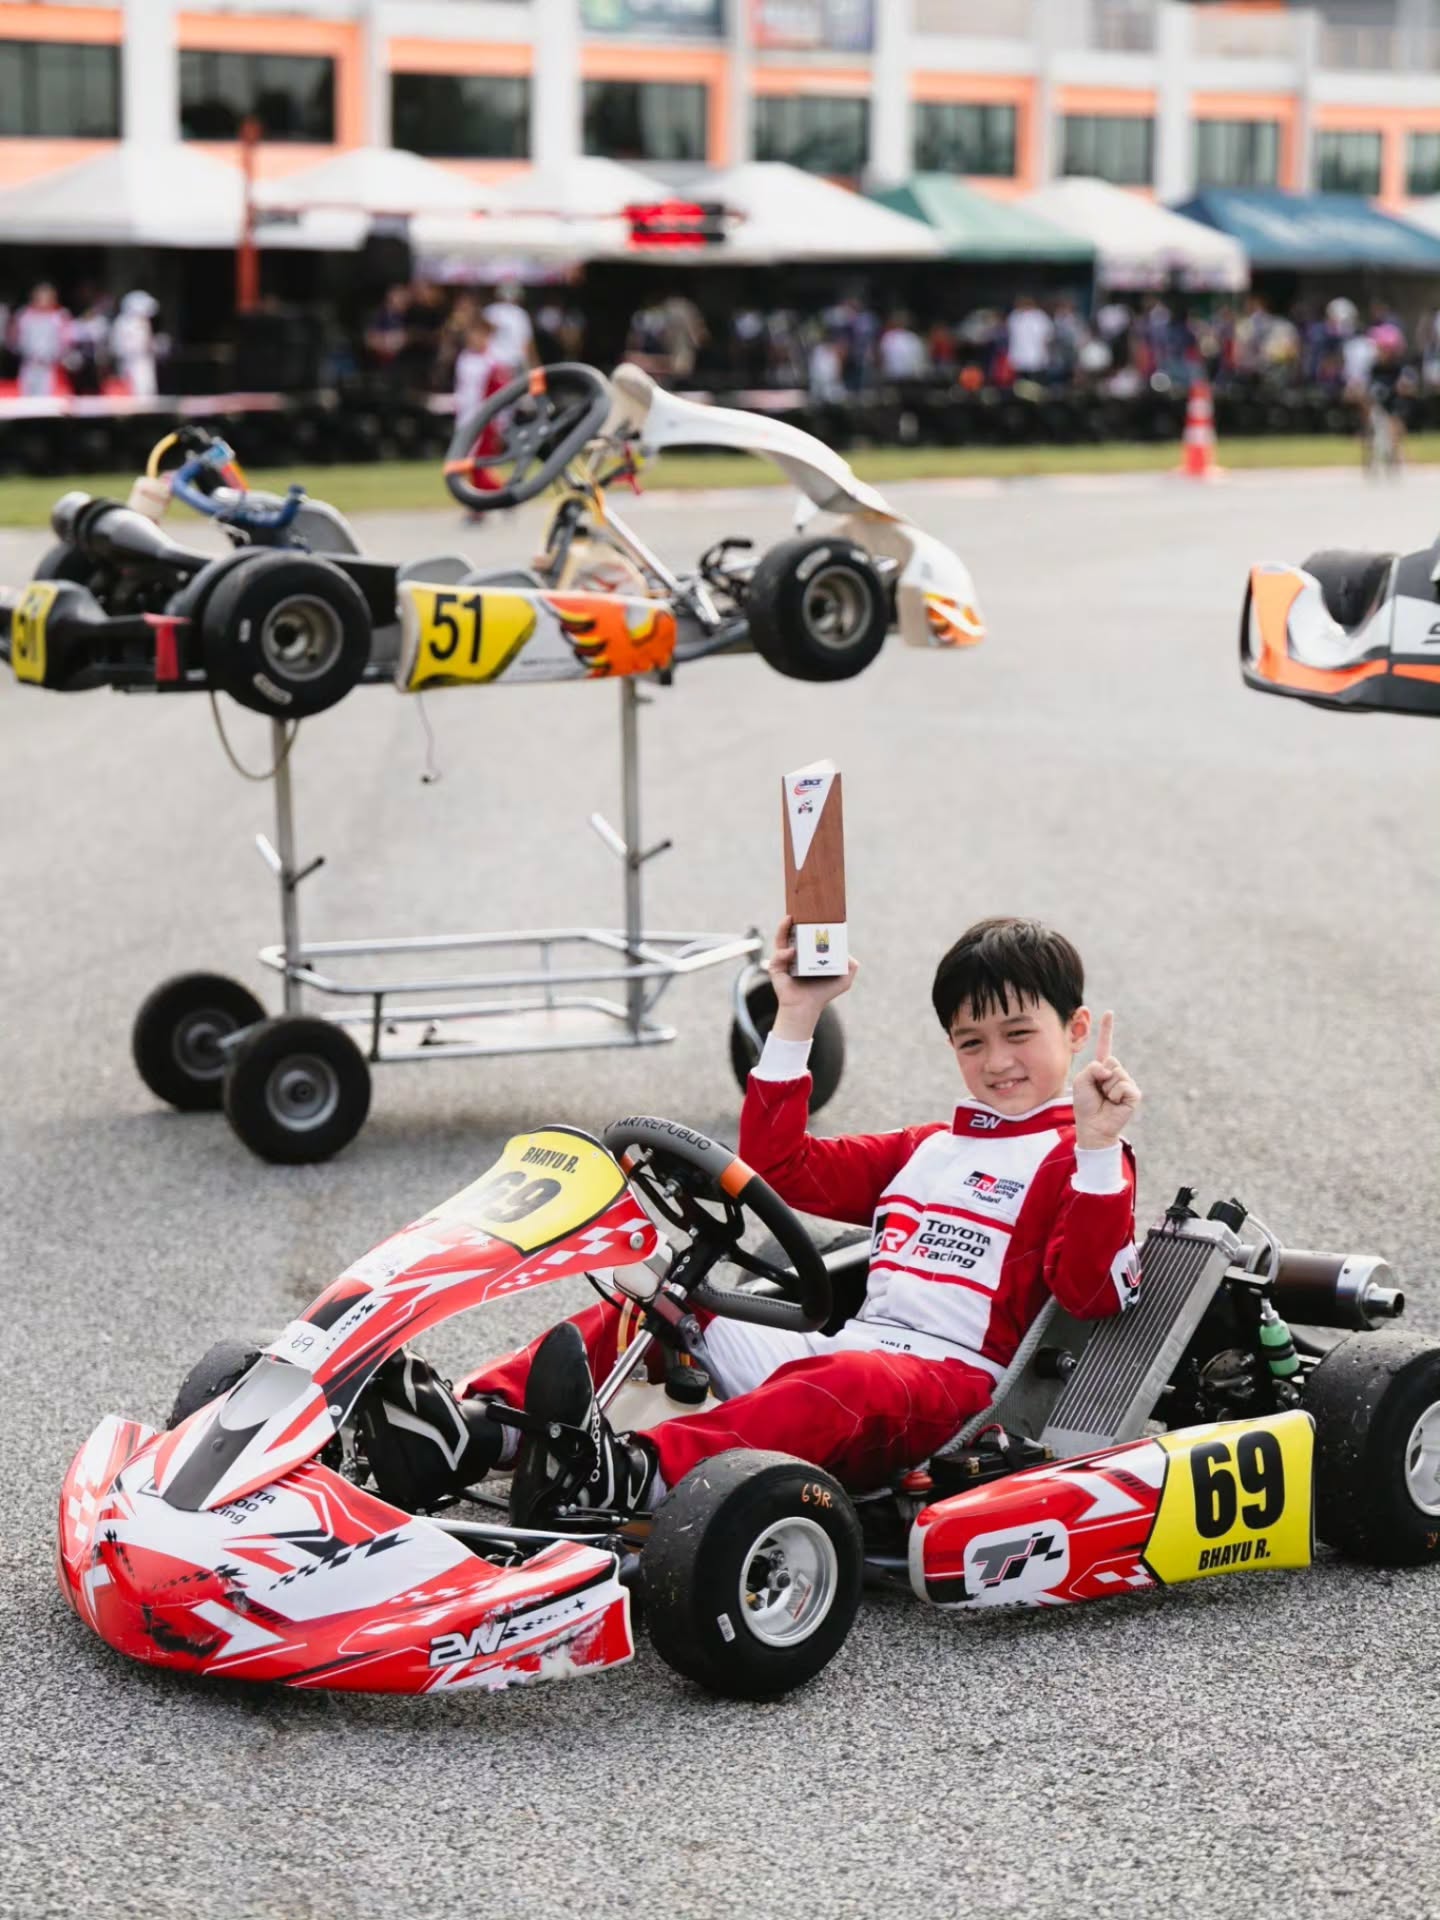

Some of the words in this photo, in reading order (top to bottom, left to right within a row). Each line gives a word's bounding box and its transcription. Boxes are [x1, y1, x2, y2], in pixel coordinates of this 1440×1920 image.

[428, 591, 483, 665] 51
[969, 1113, 1001, 1129] 2W
[520, 1146, 565, 1172] BHAYU
[563, 1154, 580, 1174] R.
[484, 1170, 563, 1224] 69
[918, 1232, 986, 1258] GAZOO
[927, 1219, 991, 1245] TOYOTA
[911, 1244, 978, 1270] Racing
[1190, 1430, 1286, 1539] 69
[1198, 1541, 1252, 1570] BHAYU
[1255, 1538, 1271, 1559] R.
[430, 1621, 507, 1667] 2W
